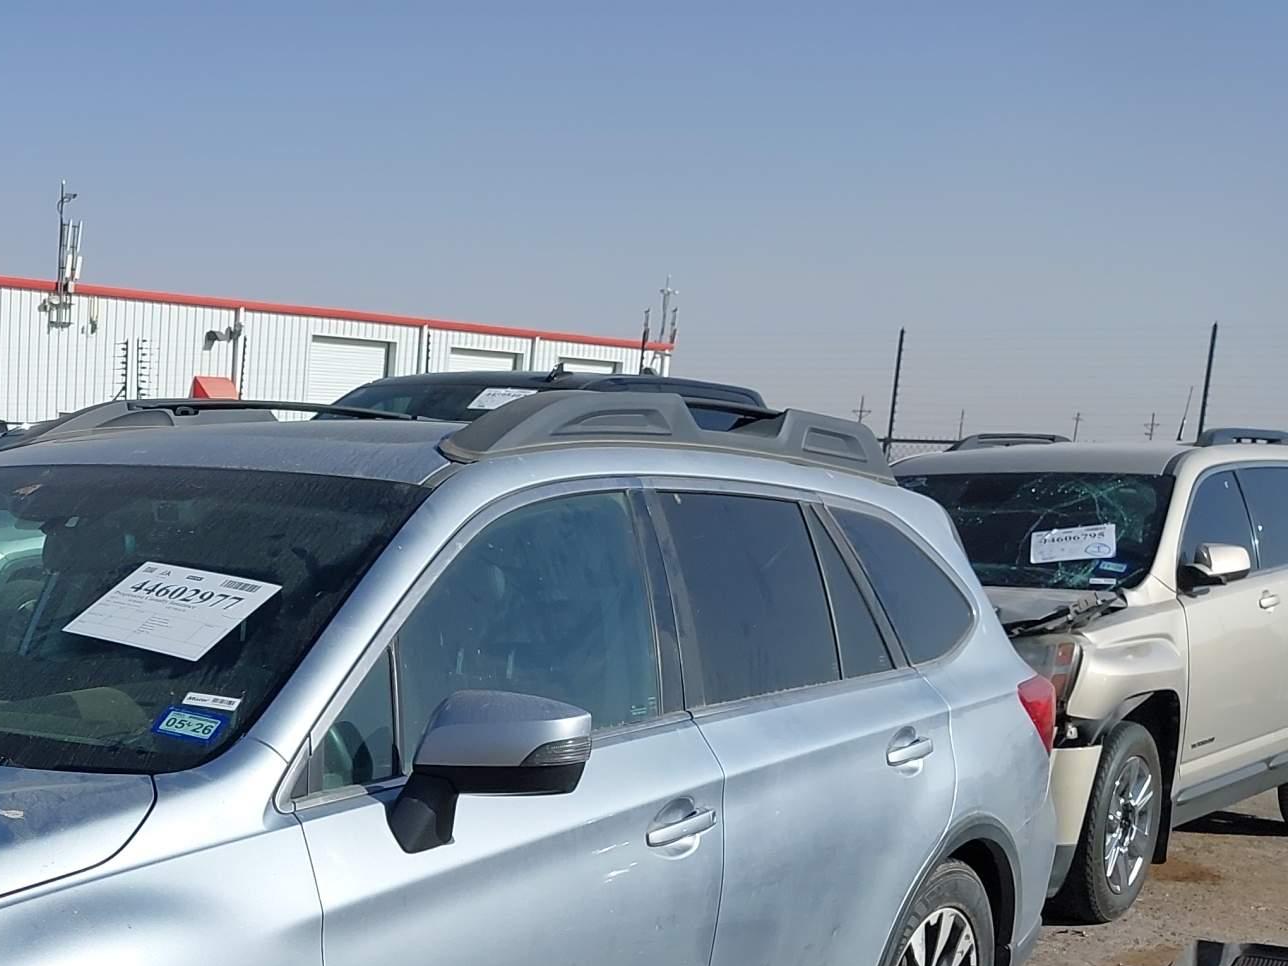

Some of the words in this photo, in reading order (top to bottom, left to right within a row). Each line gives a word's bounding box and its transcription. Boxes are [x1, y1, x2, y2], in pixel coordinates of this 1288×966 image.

[130, 580, 245, 610] 44602977
[165, 717, 186, 729] 05
[191, 722, 214, 735] 26
